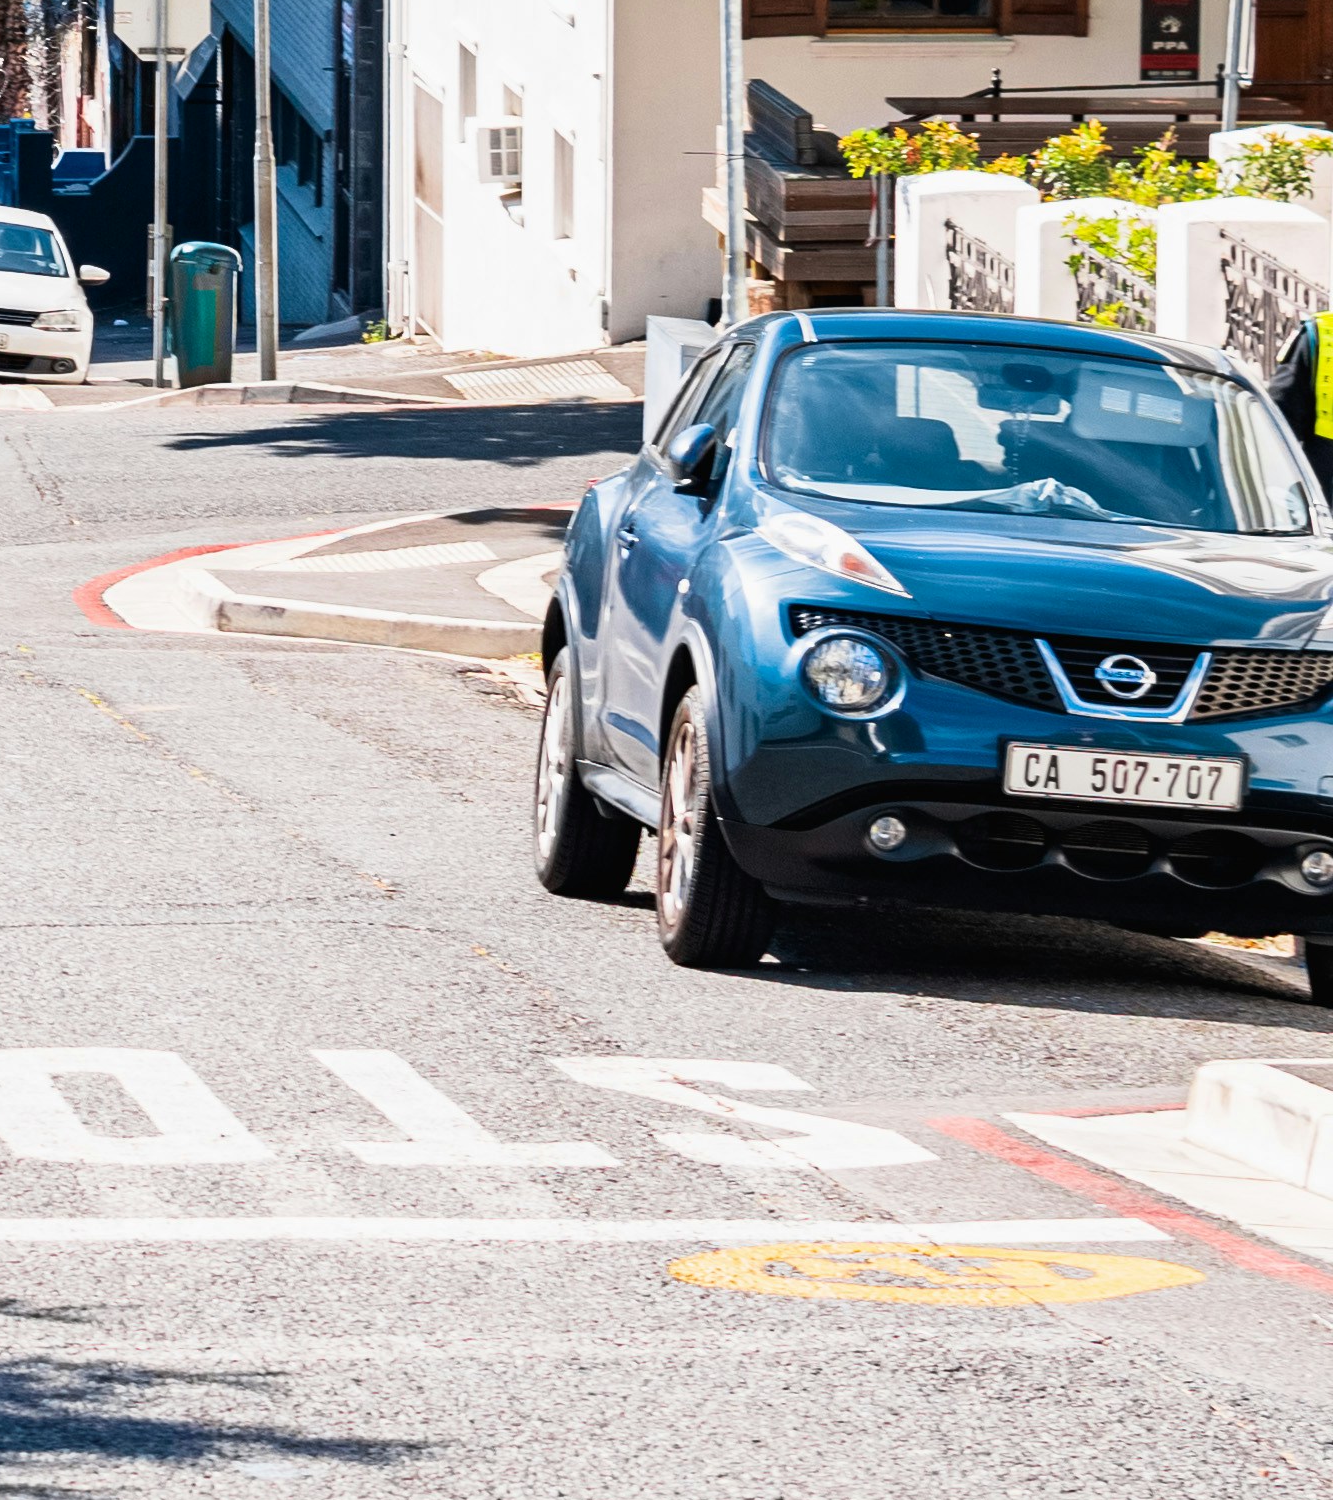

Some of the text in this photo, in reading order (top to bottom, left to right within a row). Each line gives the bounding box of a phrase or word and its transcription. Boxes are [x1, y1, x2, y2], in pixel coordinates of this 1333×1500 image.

[1152, 41, 1188, 50] PPA
[1024, 753, 1223, 801] CA 507-707
